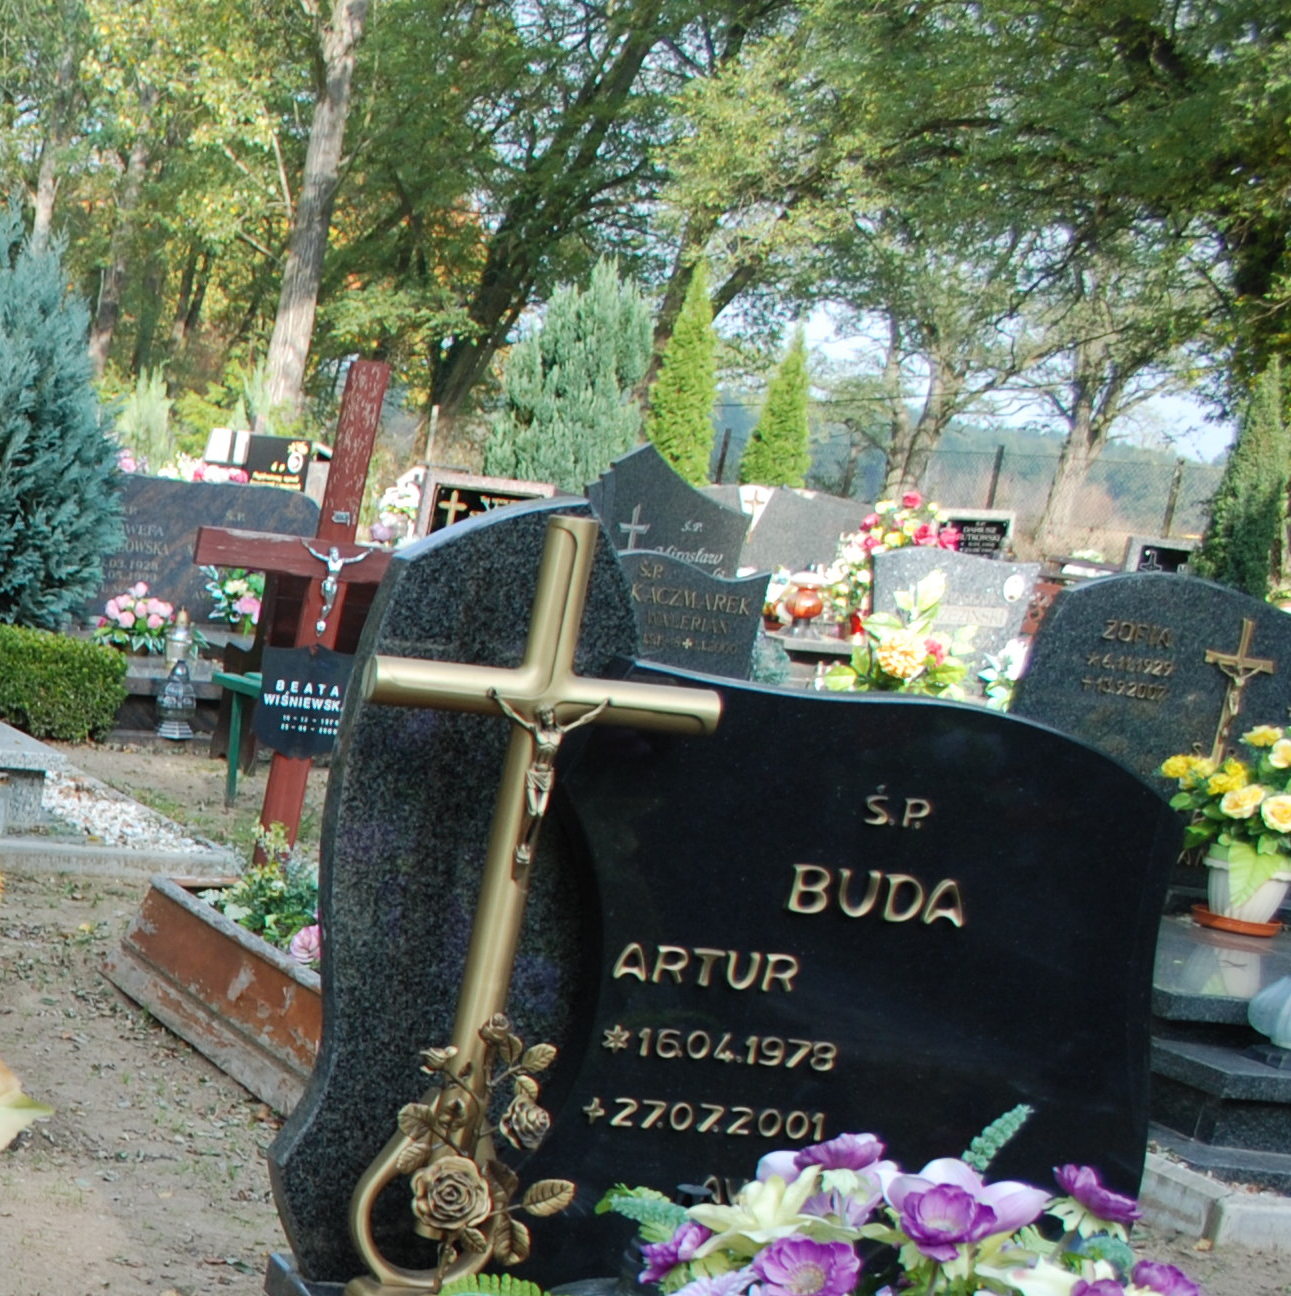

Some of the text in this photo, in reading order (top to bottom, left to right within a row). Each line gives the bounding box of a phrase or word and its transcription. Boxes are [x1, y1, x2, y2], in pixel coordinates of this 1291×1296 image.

[631, 583, 751, 616] KACZMAREK
[1101, 618, 1173, 648] ZOFIA
[263, 690, 343, 713] WIŚNIEWSK
[275, 679, 340, 697] BEATA
[787, 864, 965, 928] BUDA
[613, 942, 800, 993] ARTUR
